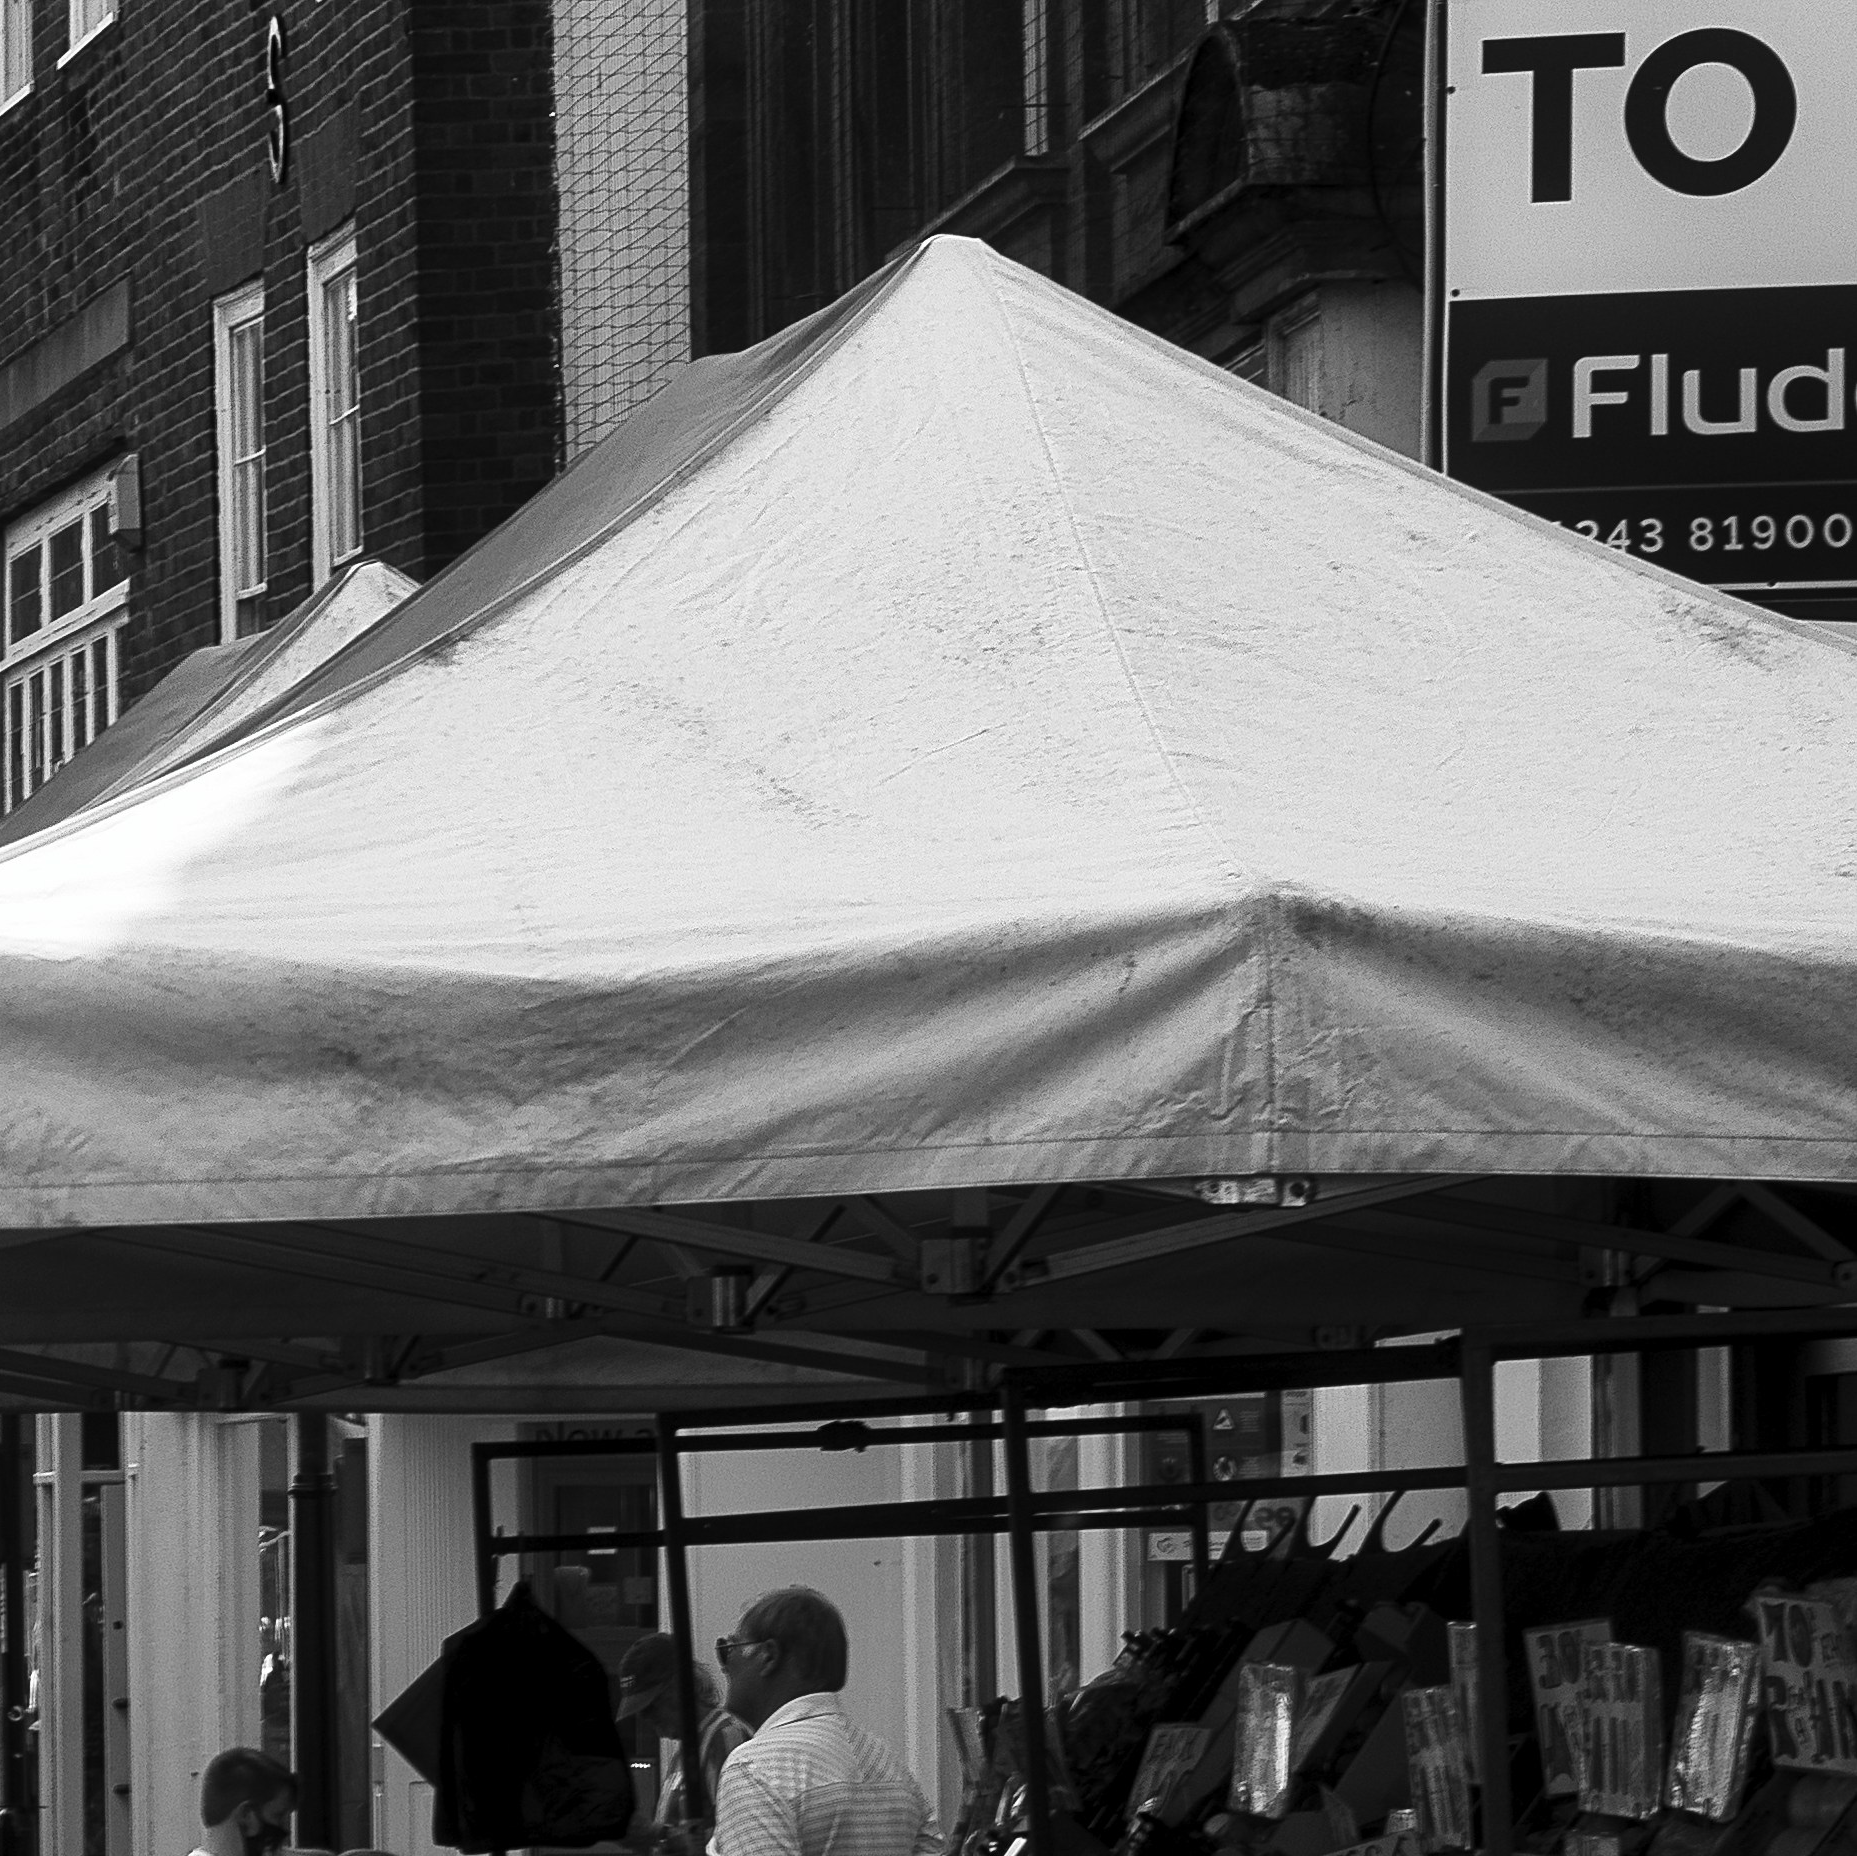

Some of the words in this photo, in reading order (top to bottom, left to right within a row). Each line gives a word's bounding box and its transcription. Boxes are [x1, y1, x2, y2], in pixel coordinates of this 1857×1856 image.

[1482, 27, 1798, 204] TO
[1571, 347, 1857, 439] Flud
[1550, 518, 1664, 553] 243
[1689, 513, 1853, 551] 81900
